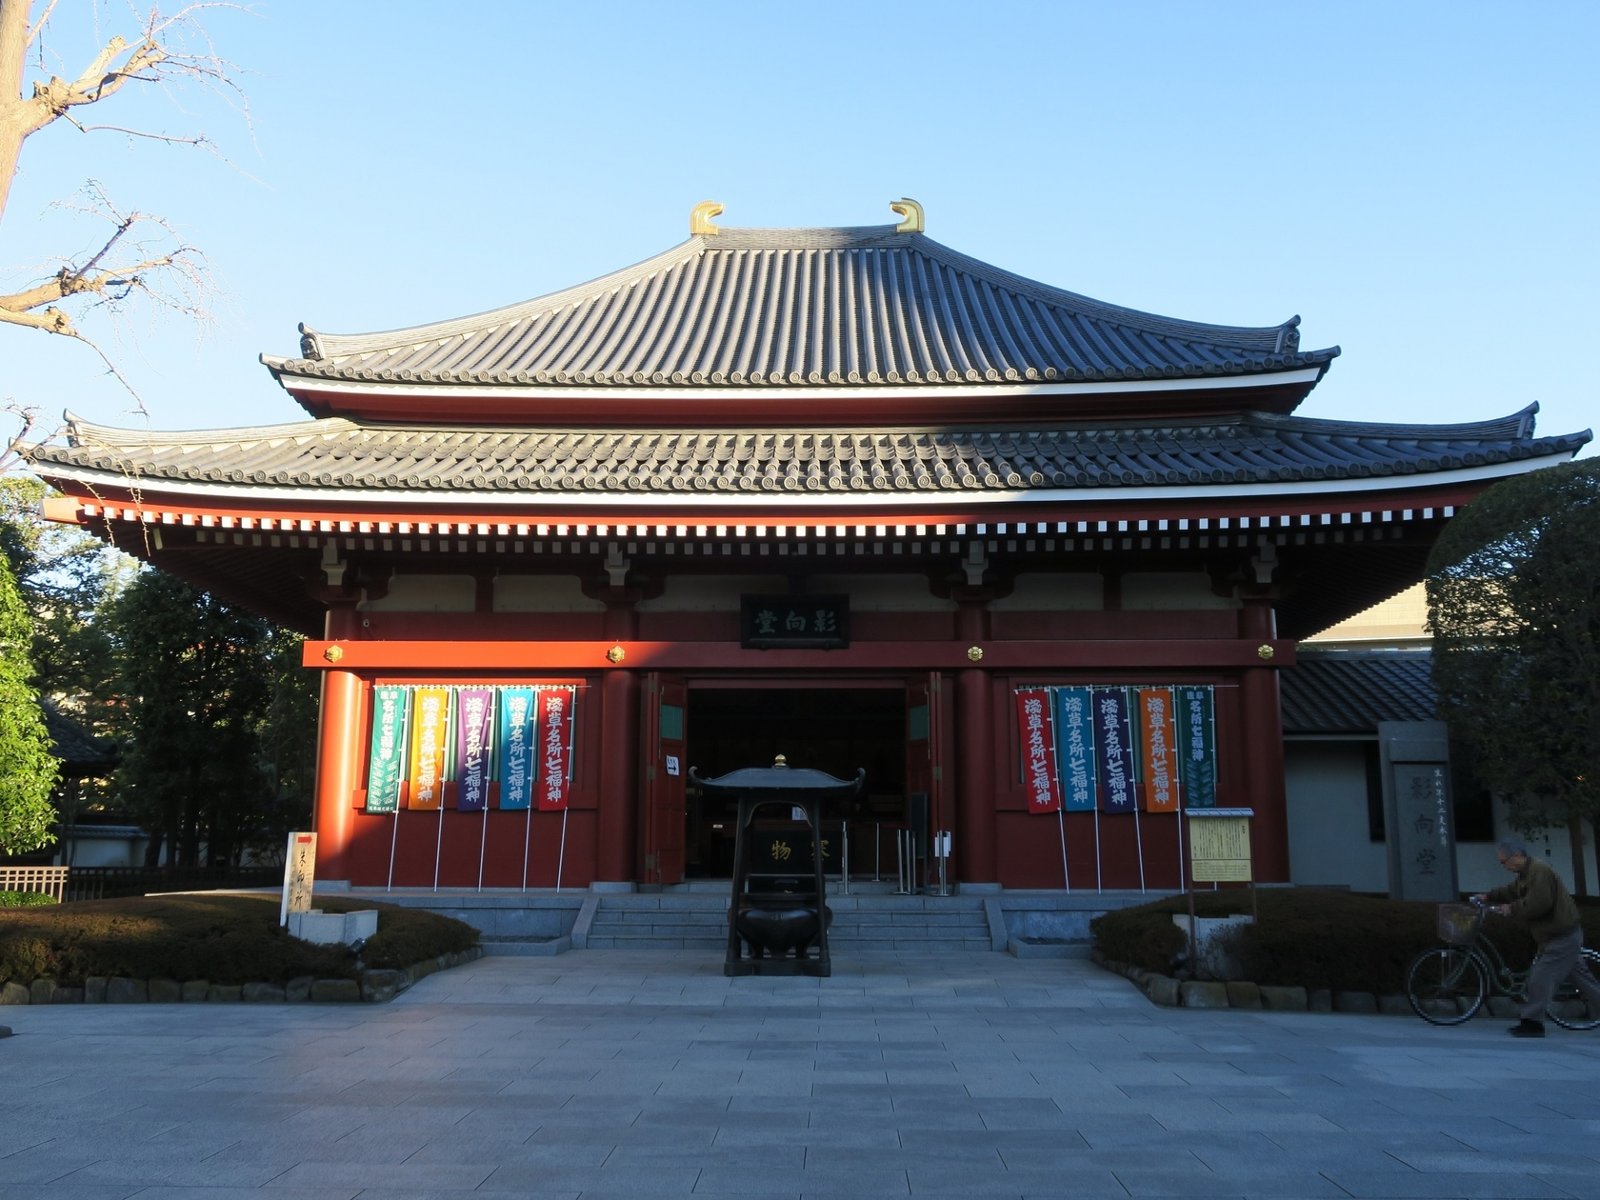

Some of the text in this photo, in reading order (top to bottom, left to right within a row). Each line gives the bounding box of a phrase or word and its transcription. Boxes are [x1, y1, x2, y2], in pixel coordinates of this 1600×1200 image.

[754, 610, 837, 634] 影向堂
[1411, 776, 1437, 875] 影向堂
